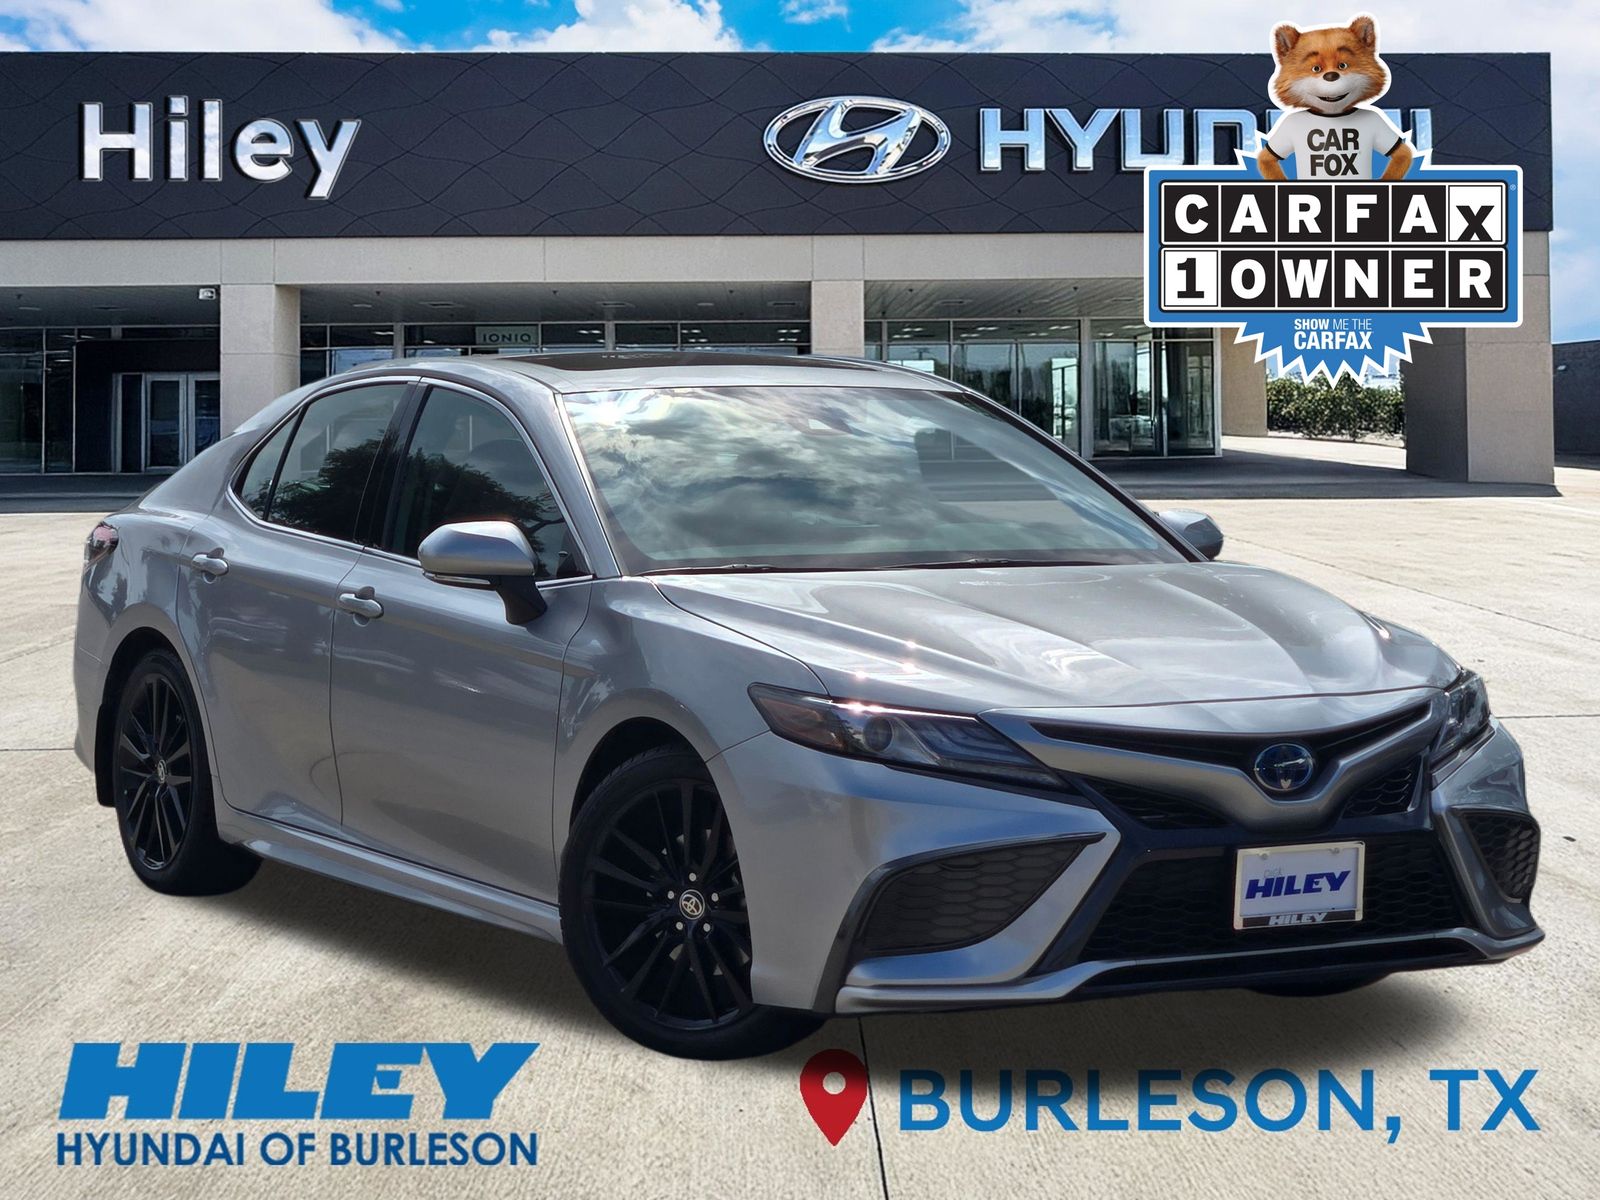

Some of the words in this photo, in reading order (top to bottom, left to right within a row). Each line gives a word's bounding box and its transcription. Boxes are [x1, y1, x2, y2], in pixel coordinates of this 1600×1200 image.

[80, 95, 361, 199] Hiley
[483, 333, 531, 343] IONIQ
[1245, 870, 1351, 899] HILEY
[1268, 912, 1328, 926] HILEY
